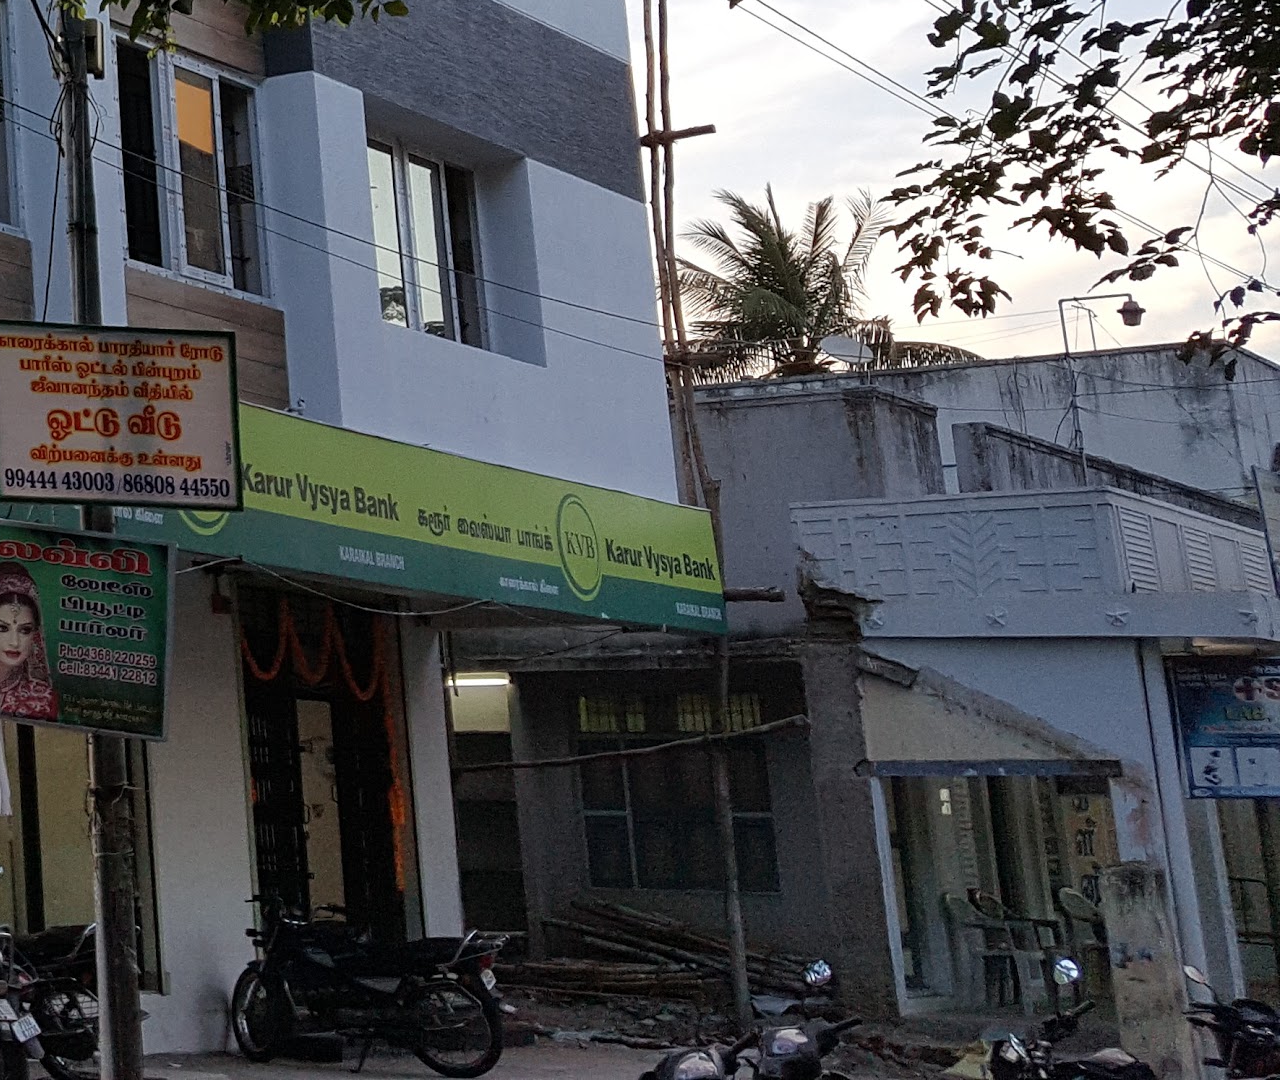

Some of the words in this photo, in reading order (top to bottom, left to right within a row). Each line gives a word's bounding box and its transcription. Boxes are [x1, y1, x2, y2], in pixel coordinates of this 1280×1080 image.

[97, 339, 176, 359] பாரதியார்
[179, 343, 224, 362] ரோடு
[18, 355, 73, 374] பாரீஸ்
[131, 361, 202, 381] பின்புறம்
[29, 375, 130, 399] ஜீவானந்தம்
[132, 380, 194, 401] வீதியில்
[127, 404, 183, 441] வீடு
[29, 443, 134, 467] விற்பனைக்கு
[137, 448, 202, 472] உள்ளது
[4, 467, 59, 490] 99444
[61, 470, 116, 492] 43003
[122, 473, 176, 495] 86808
[179, 477, 231, 498] 44550
[241, 463, 292, 499] Karur
[295, 472, 351, 515] Vysya
[353, 485, 400, 521] Bank
[417, 504, 451, 536] கரூர்
[456, 513, 512, 543] வைஸ்யா
[516, 523, 554, 552] பாங்க்
[563, 530, 596, 559] KVB
[604, 537, 643, 567] Karur
[642, 544, 682, 579] Vysya
[682, 552, 717, 581] Bank
[60, 573, 154, 598] லேடீஸ்
[60, 595, 147, 620] பியூட்டி
[58, 619, 148, 642] பார்லர்
[58, 643, 112, 664] Ph:04368
[113, 648, 158, 668] 220259
[58, 659, 119, 681] Cell:83441
[120, 667, 158, 686] 22812
